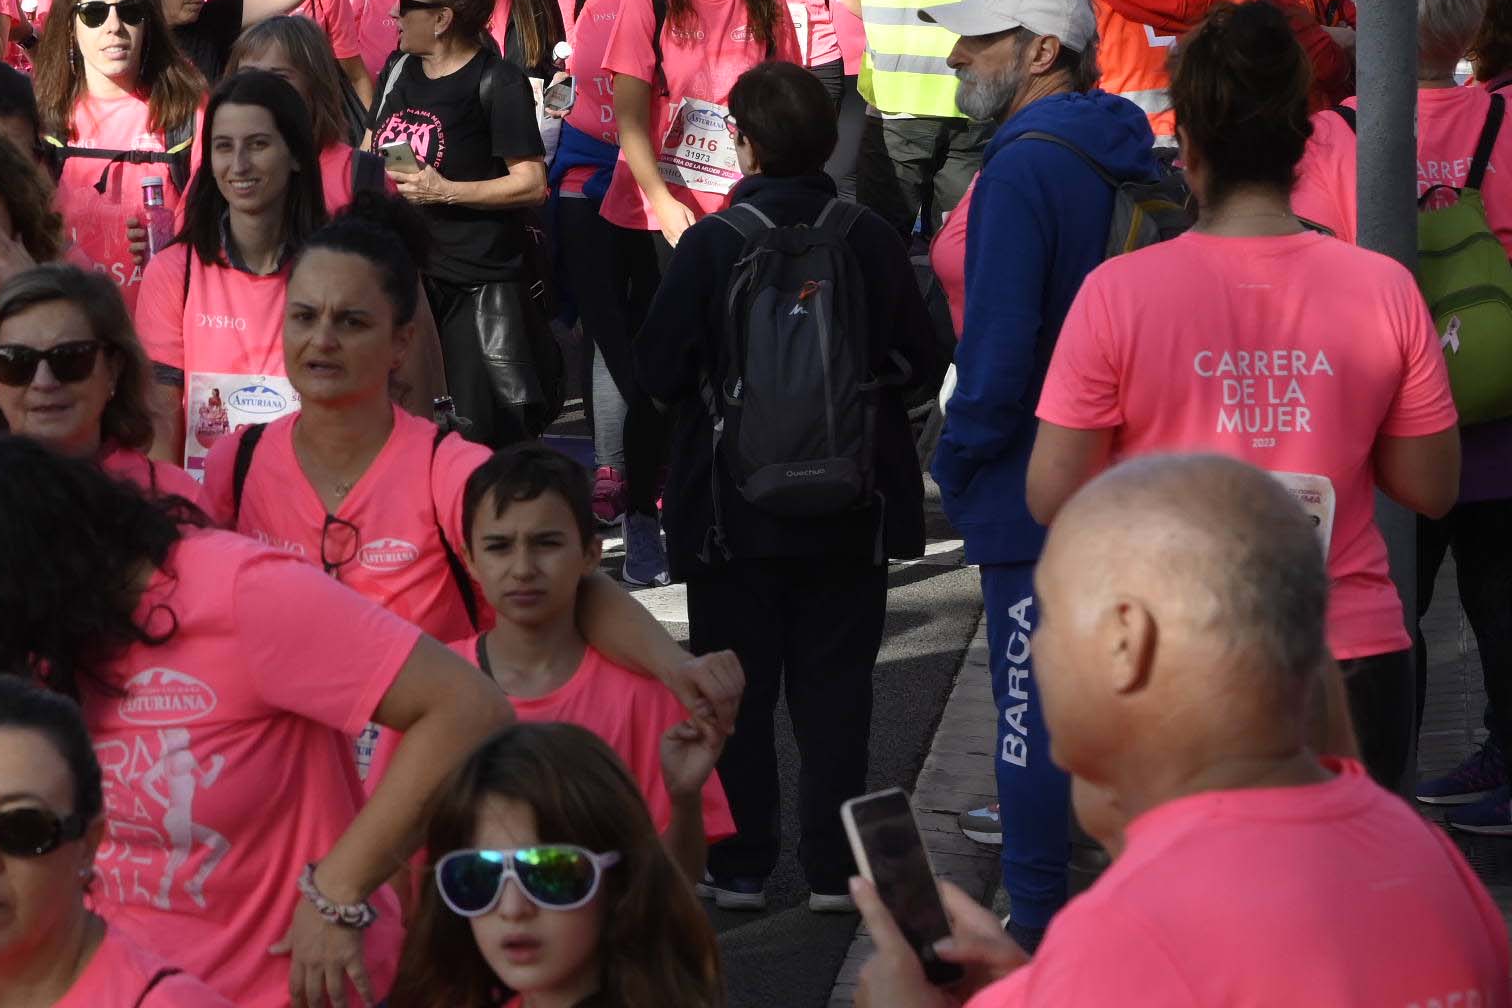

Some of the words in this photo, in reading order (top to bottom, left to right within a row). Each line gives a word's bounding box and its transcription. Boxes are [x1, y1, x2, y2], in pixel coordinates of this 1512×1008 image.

[685, 134, 719, 152] 016
[684, 149, 711, 163] 31973
[1416, 157, 1497, 179] ARRE
[1193, 349, 1334, 377] CARRERA
[1222, 378, 1256, 405] DE
[1267, 377, 1306, 404] LA
[233, 395, 282, 409] ASTURIANA
[1216, 406, 1312, 433] MUJER
[1252, 437, 1277, 449] 2023
